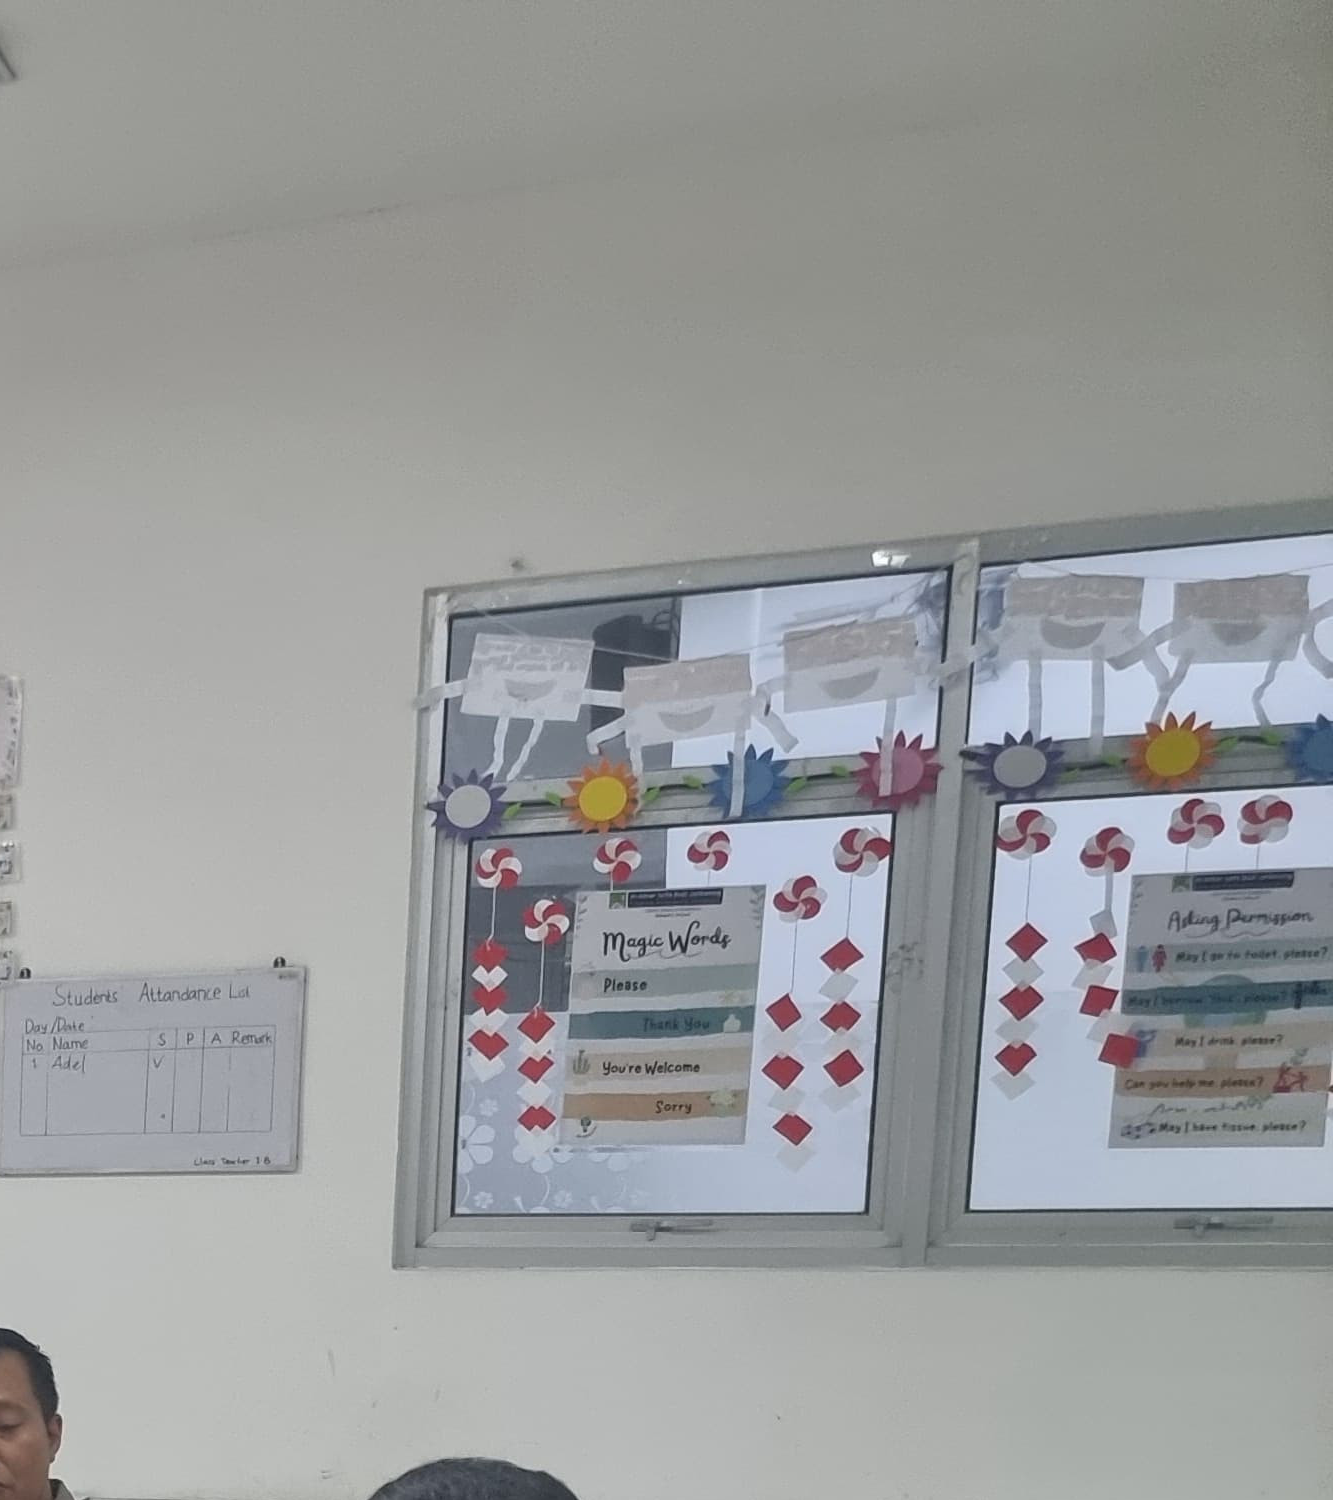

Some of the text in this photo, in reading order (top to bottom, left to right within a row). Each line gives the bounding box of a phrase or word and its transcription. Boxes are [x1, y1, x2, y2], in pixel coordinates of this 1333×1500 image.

[1168, 907, 1315, 932] Asking Permission
[603, 920, 732, 963] Magic Words
[1176, 949, 1197, 964] May
[604, 977, 648, 993] Please
[643, 1017, 711, 1032] Thank You
[52, 1037, 89, 1051] Name
[158, 1032, 167, 1047] S
[186, 1031, 195, 1046] P
[210, 1031, 223, 1045] A
[232, 1030, 273, 1046] Remark
[1175, 1036, 1196, 1048] May
[603, 1060, 701, 1076] You're Welcome
[1125, 1078, 1147, 1091] Can
[655, 1100, 693, 1114] Sorry
[1159, 1122, 1181, 1135] May
